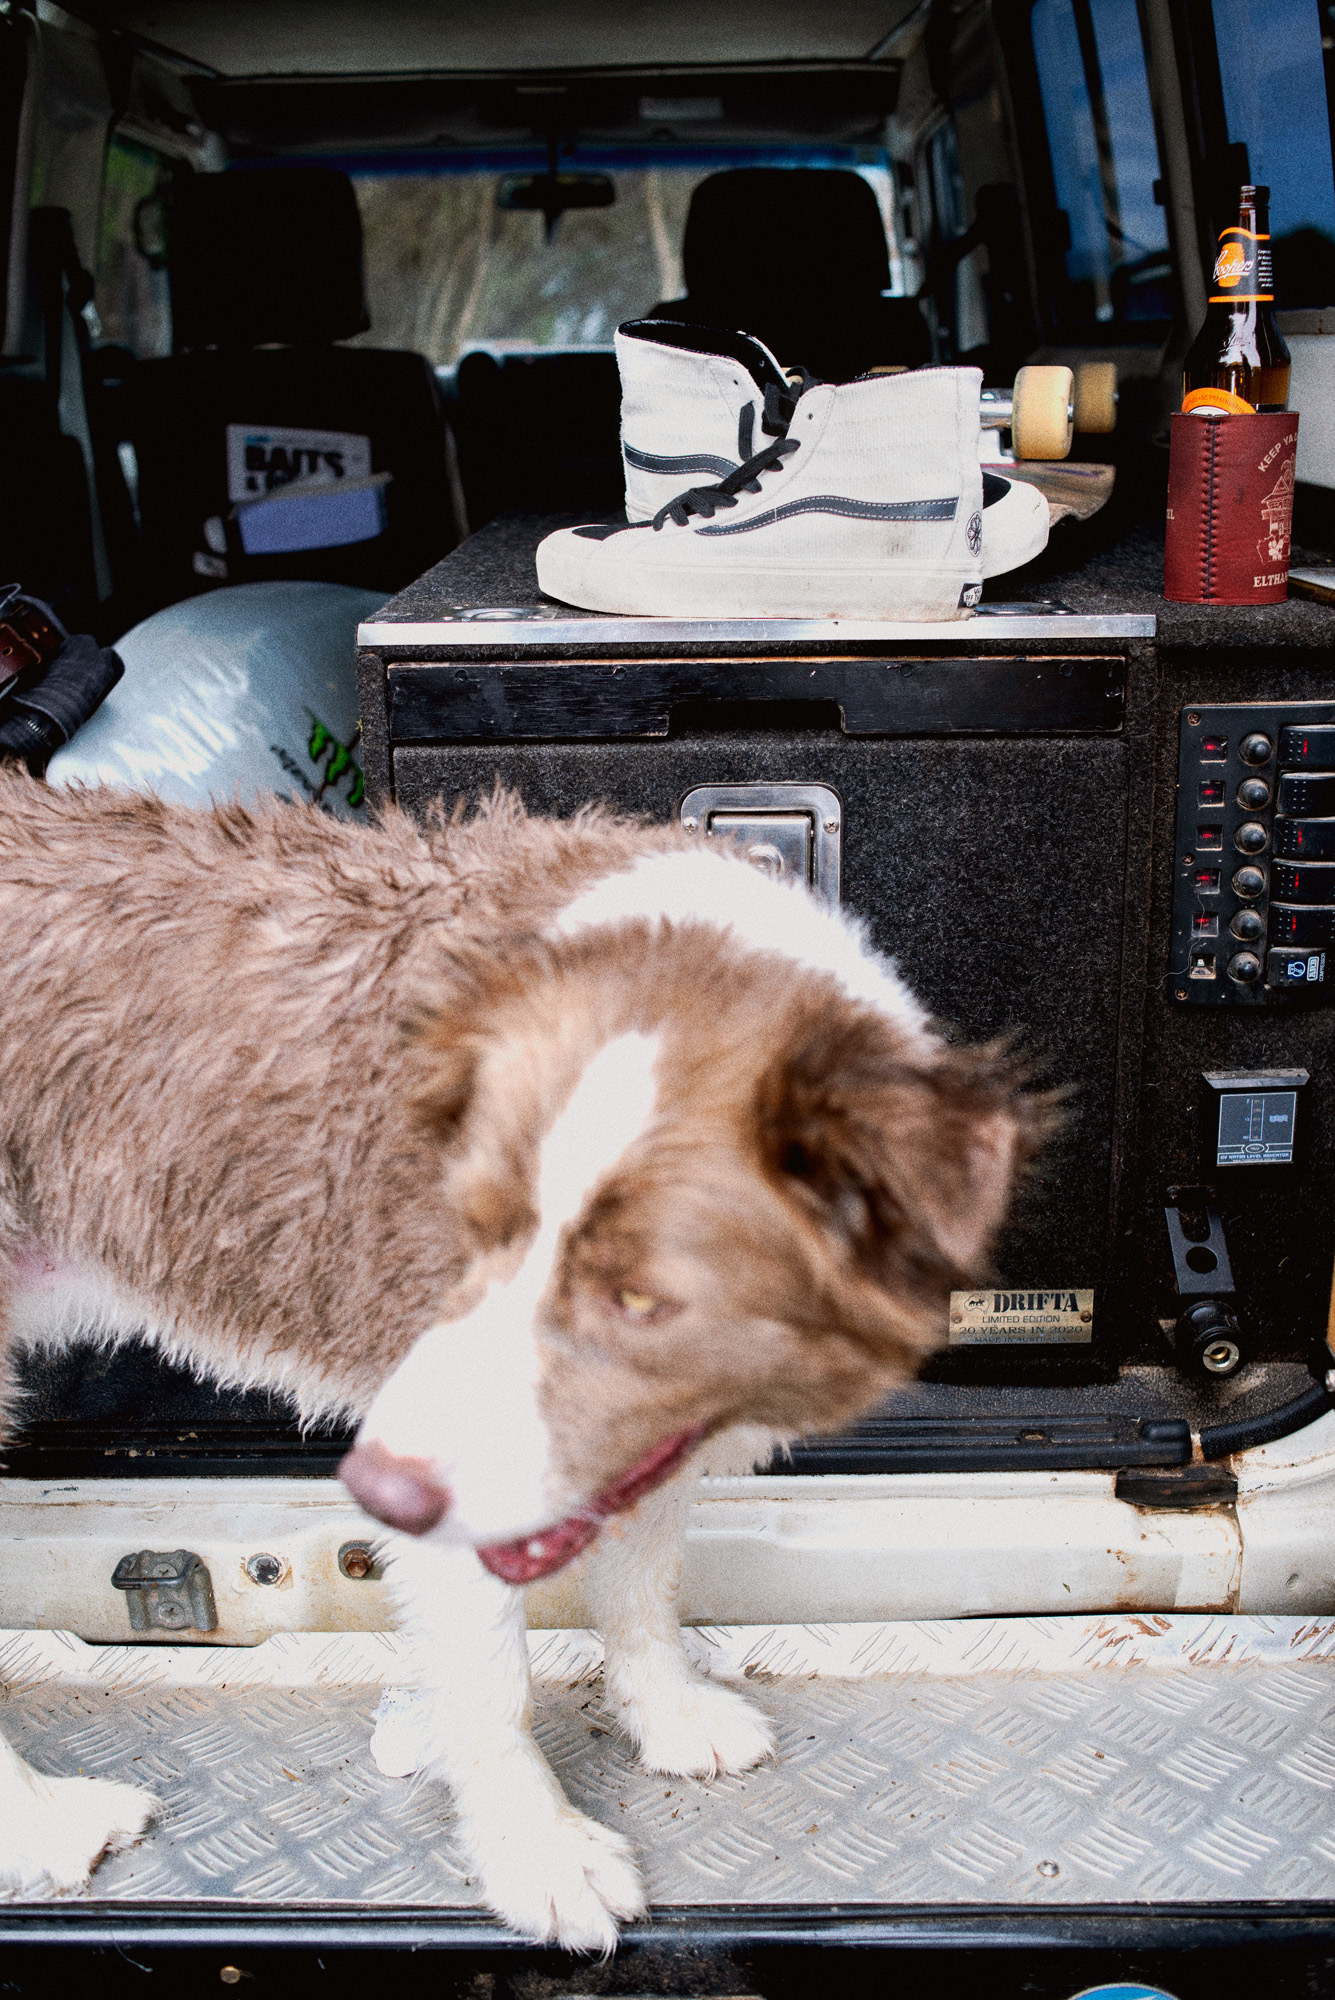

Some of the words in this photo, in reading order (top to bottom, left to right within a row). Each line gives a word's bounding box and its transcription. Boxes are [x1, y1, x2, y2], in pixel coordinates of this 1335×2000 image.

[1213, 250, 1255, 280] Coopers
[246, 445, 345, 478] BAITS
[1257, 442, 1282, 473] KEEP
[993, 1292, 1080, 1313] DRIFTA
[959, 1326, 976, 1335] 20
[981, 1326, 1026, 1335] YEARS
[1031, 1325, 1045, 1333] IN
[1049, 1325, 1083, 1334] 2020
[982, 1315, 1020, 1324] LIMITED
[1022, 1315, 1060, 1323] EDITION
